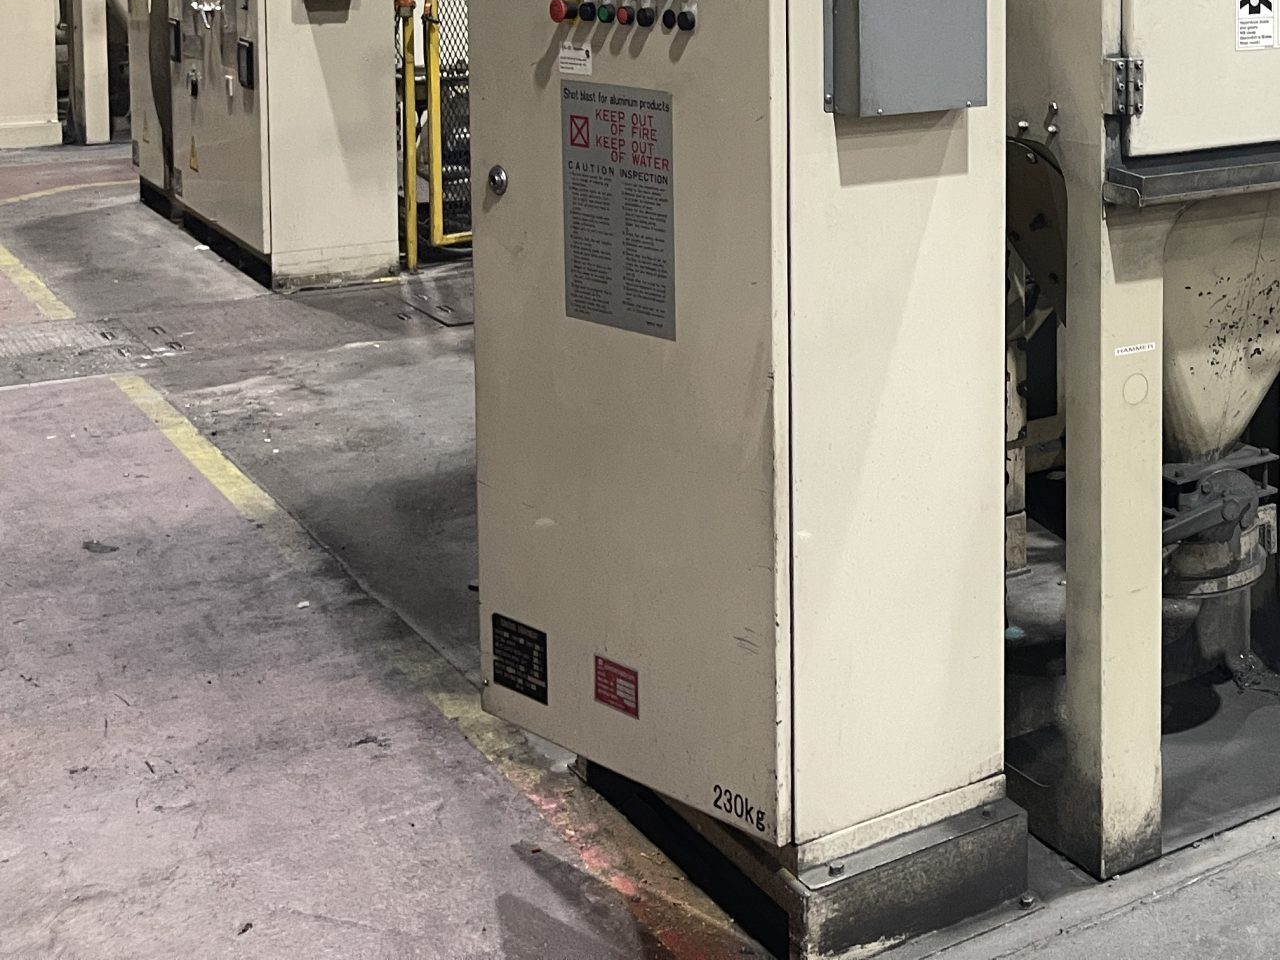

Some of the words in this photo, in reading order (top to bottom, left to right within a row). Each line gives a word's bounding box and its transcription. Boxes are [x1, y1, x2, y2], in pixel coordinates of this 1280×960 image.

[563, 88, 579, 100] Shot
[580, 90, 596, 102] blast
[598, 92, 607, 103] for
[639, 100, 670, 113] products
[595, 109, 626, 122] KEEP
[631, 113, 654, 127] OUT
[610, 123, 626, 136] OF
[631, 126, 657, 142] FIRE
[596, 135, 626, 150] KEEP
[631, 141, 654, 155] OUT
[568, 161, 615, 176] CAUTION
[610, 150, 626, 163] OF
[631, 153, 669, 171] WATER
[620, 168, 669, 185] INSPECTION
[713, 784, 766, 832] 230kg
